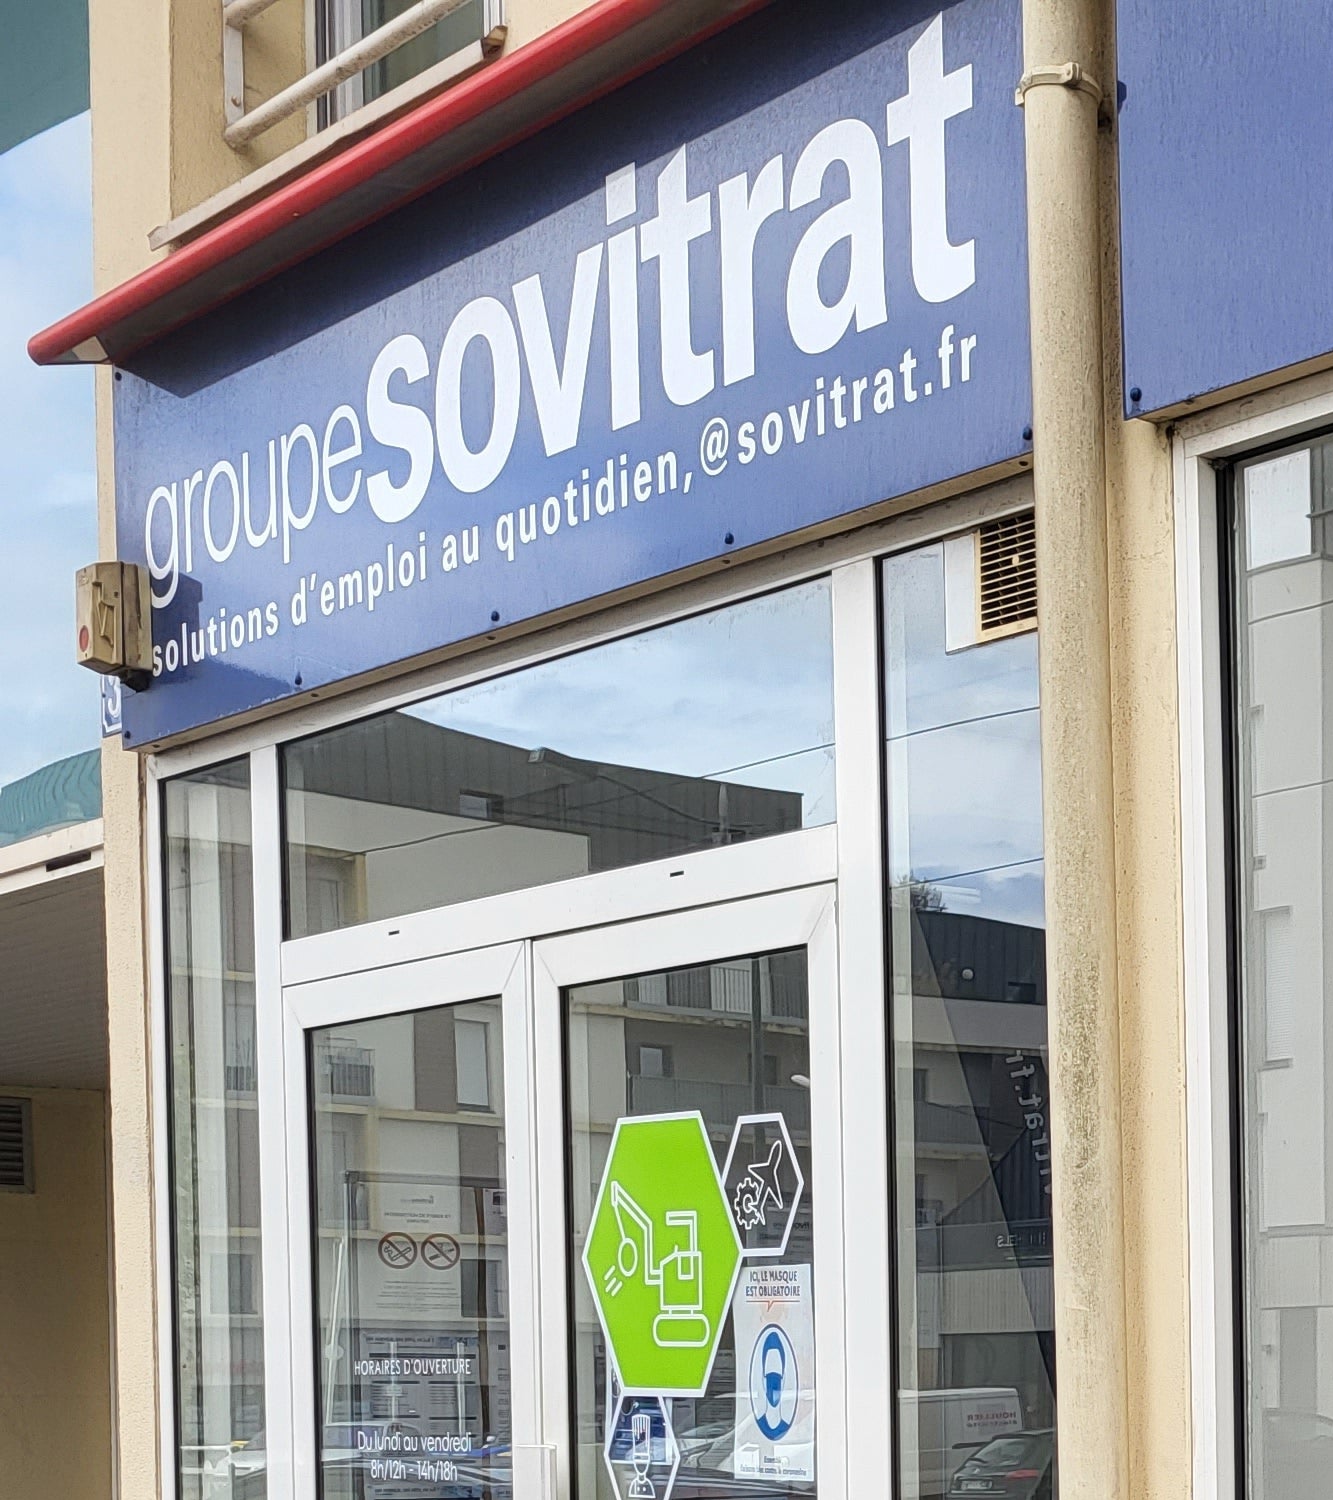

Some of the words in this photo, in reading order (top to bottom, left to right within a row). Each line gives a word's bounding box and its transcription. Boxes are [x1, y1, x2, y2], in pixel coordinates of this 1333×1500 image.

[151, 601, 280, 678] solutions
[441, 524, 480, 574] au
[769, 1270, 798, 1283] MASQUE
[745, 1285, 758, 1297] EST
[759, 1285, 801, 1297] OBLIGATOIRE
[354, 1359, 401, 1376] HORAIRES
[357, 1431, 373, 1451] Du
[374, 1430, 401, 1451] lundi
[403, 1436, 418, 1452] au
[421, 1431, 472, 1452] vendredi
[370, 1459, 407, 1481] 8h/12h
[417, 1460, 458, 1482] 14h/18h
